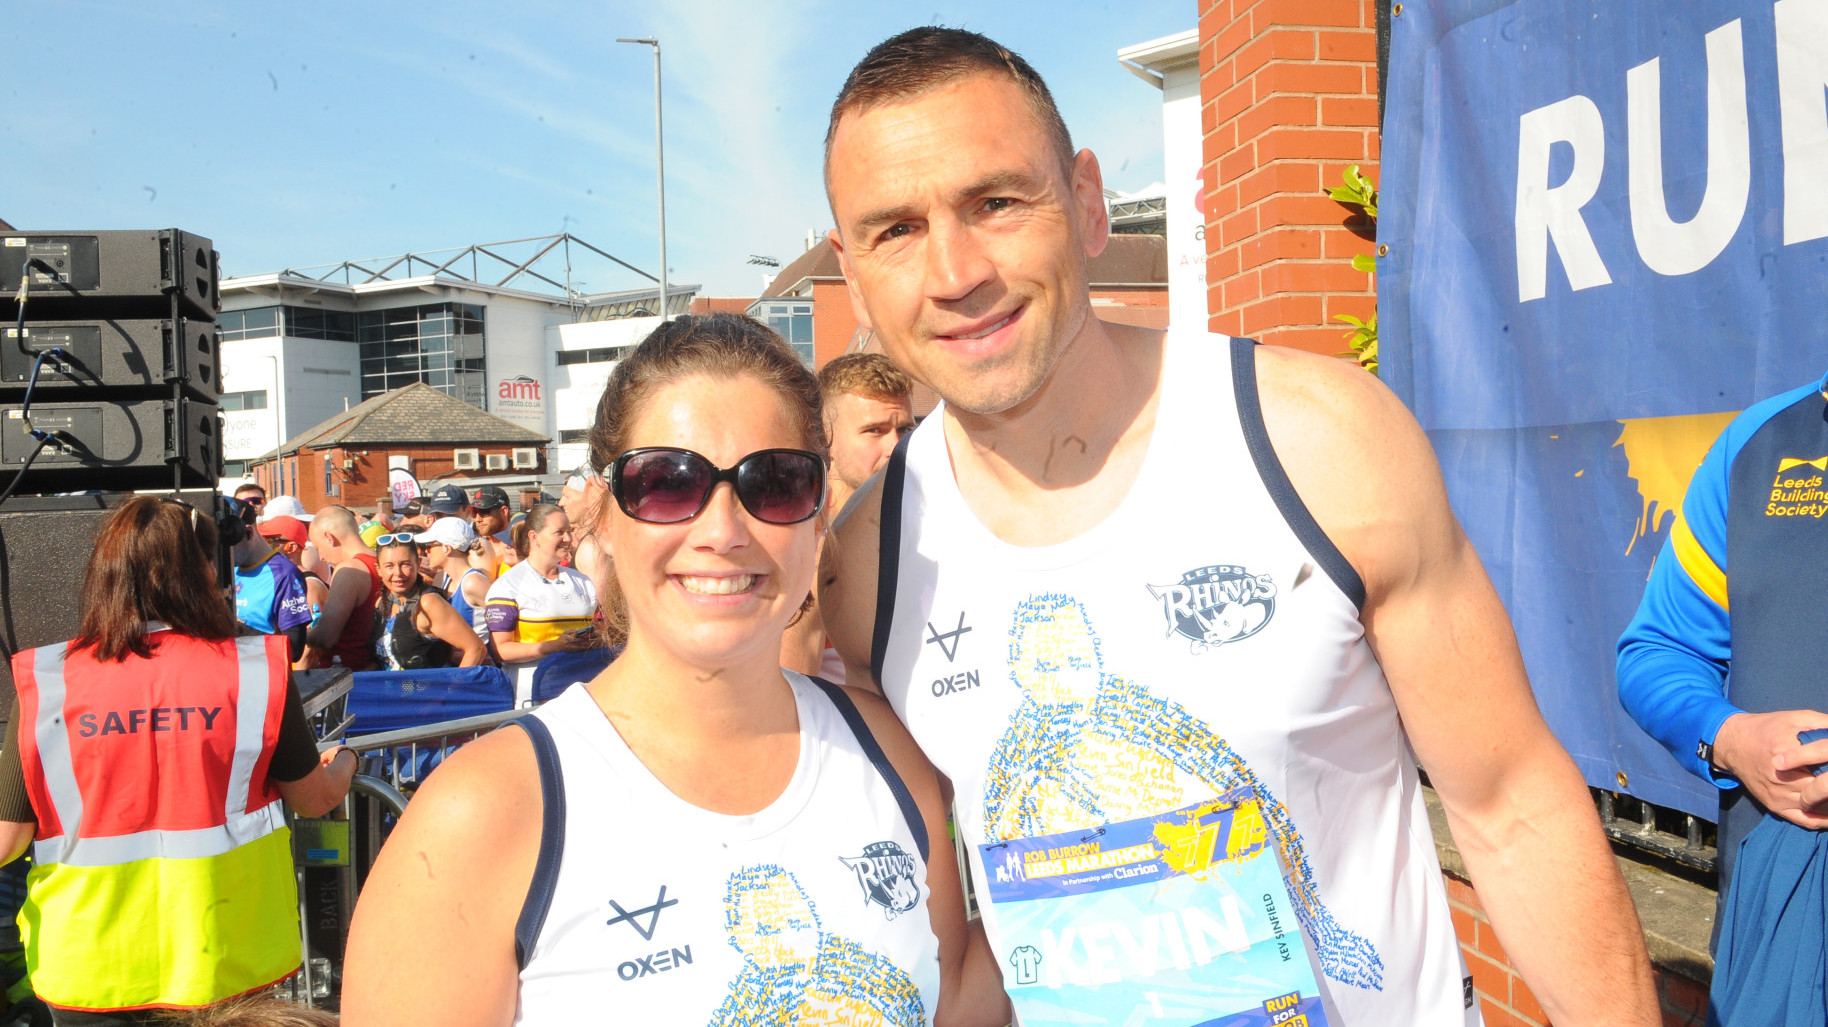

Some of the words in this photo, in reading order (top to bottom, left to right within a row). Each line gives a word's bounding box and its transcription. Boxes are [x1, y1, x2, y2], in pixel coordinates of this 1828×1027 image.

[498, 380, 541, 400] amt
[499, 400, 541, 408] amtauto.co.uk
[1773, 475, 1823, 489] Leeds
[1765, 503, 1828, 518] Society
[1185, 565, 1245, 581] LEEDS
[281, 596, 305, 610] Alzhe
[1029, 591, 1067, 604] Lindsey
[1018, 601, 1046, 615] Maya
[1020, 612, 1056, 623] Jackson
[931, 669, 981, 698] OXEN
[79, 706, 222, 738] SAFETY
[866, 842, 901, 854] LEEDS
[1024, 850, 1047, 863] ROB
[1048, 842, 1100, 860] BURROW
[741, 863, 778, 874] Lindsey
[1025, 861, 1065, 878] LEEDS
[1066, 845, 1156, 873] MARATHON
[730, 872, 760, 884] Maya
[1069, 874, 1101, 885] Partnership
[1101, 872, 1114, 880] with
[1113, 863, 1159, 880] Clarion
[733, 881, 770, 892] Jackson
[321, 881, 338, 930] BACK
[1263, 893, 1285, 940] SINFIELD
[1040, 894, 1251, 989] KEVIN
[1278, 942, 1291, 962] KEV
[617, 945, 694, 981] OXEN
[1266, 993, 1299, 1013] RUN
[1273, 1008, 1296, 1025] FOR
